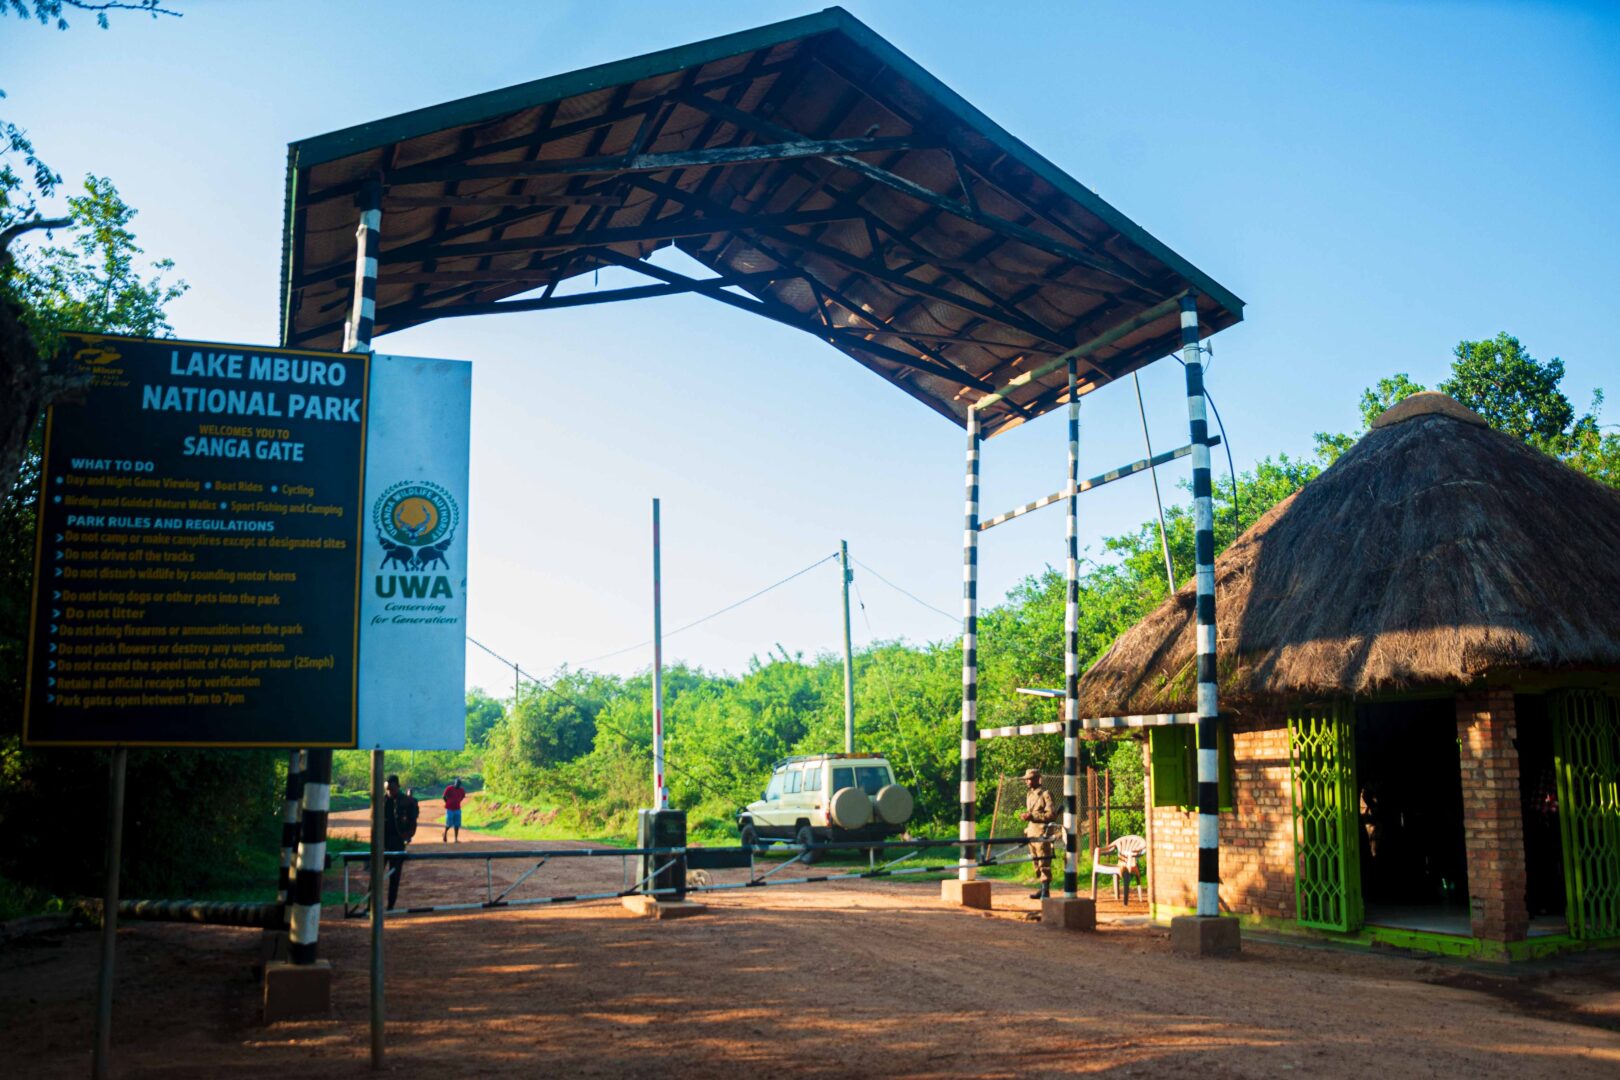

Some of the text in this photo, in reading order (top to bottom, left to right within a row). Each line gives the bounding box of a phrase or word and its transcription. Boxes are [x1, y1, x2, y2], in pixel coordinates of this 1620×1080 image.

[170, 351, 346, 386] LAKE MBURO
[142, 384, 361, 422] NATIONAL PARK
[199, 424, 290, 440] WELCOMES YOU TO
[183, 436, 304, 462] SANGA GATE
[70, 458, 154, 472] WHAT TO DO
[66, 474, 314, 497] Day and Night Game Viewing Boat Rides Cycling
[64, 494, 343, 517] Birding and Guided Nature Walks Sport Fishing and Camping
[384, 486, 449, 541] UGANDA WILDLIFE AUTHORITY
[67, 514, 274, 532] PARK RULES AND REGULATIONS
[65, 530, 346, 550] Do not camp or make campfires except at designated sites
[65, 548, 195, 562] Do not drive off the tracks
[64, 566, 296, 584] Do not disturb wildlife by sounding motor horns
[376, 575, 453, 599] UWA
[62, 590, 280, 607] Do not bring dogs or other pets into the park
[65, 607, 146, 619] Do not litter
[384, 602, 446, 614] Conserving
[370, 614, 458, 626] for Generations
[60, 624, 303, 639] Do not bring firearms or ammunition into the park
[58, 642, 284, 656] Do not pick flowers or destroy any vegetation
[58, 654, 334, 673] Do not exceed the speed limit of 40km per hour (25mph)
[58, 676, 260, 691] Retain all official receipts for verification
[57, 692, 245, 708] Park gates open between 7am to 7pm
